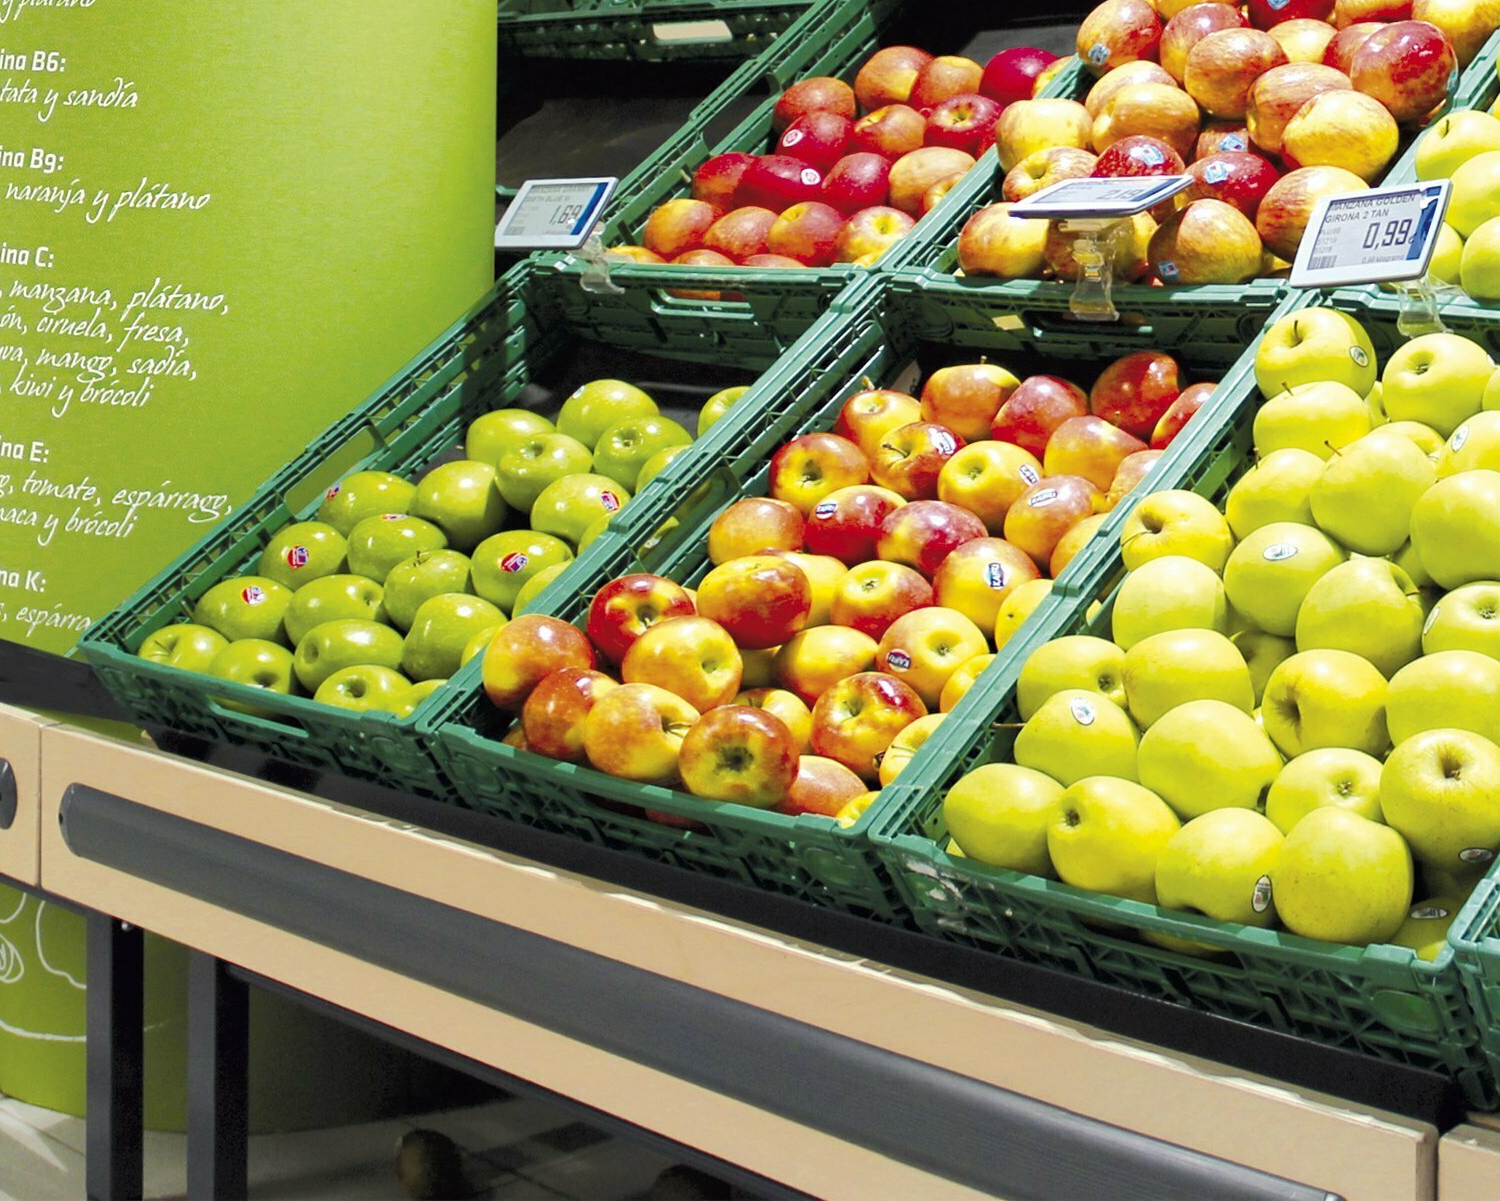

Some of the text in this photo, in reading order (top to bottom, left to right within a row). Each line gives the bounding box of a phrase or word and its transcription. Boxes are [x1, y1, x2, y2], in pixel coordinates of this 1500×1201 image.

[31, 50, 66, 73] B6:
[38, 88, 60, 122] y
[63, 77, 139, 108] sandía
[30, 148, 65, 174] B9:
[5, 178, 85, 213] naranja
[86, 189, 109, 224] y
[107, 177, 211, 223] plátano
[1325, 209, 1390, 224] GIRONA 2 TAN
[1329, 194, 1416, 212] MANZANA GOLDEN
[34, 246, 55, 268] C:
[9, 279, 118, 313] manzana,
[120, 277, 230, 323] plátano,
[36, 308, 114, 343] ciruela,
[117, 312, 190, 352] fresa,
[35, 347, 118, 384] mango,
[126, 345, 199, 382] sadía,
[9, 361, 155, 419] kiwi y brócoli
[29, 441, 50, 464] E:
[22, 470, 102, 508] tomate,
[111, 481, 233, 524] espárrago,
[37, 513, 60, 547] y
[64, 509, 138, 539] brócoli
[25, 570, 47, 593] K:
[15, 603, 93, 638] espárra
